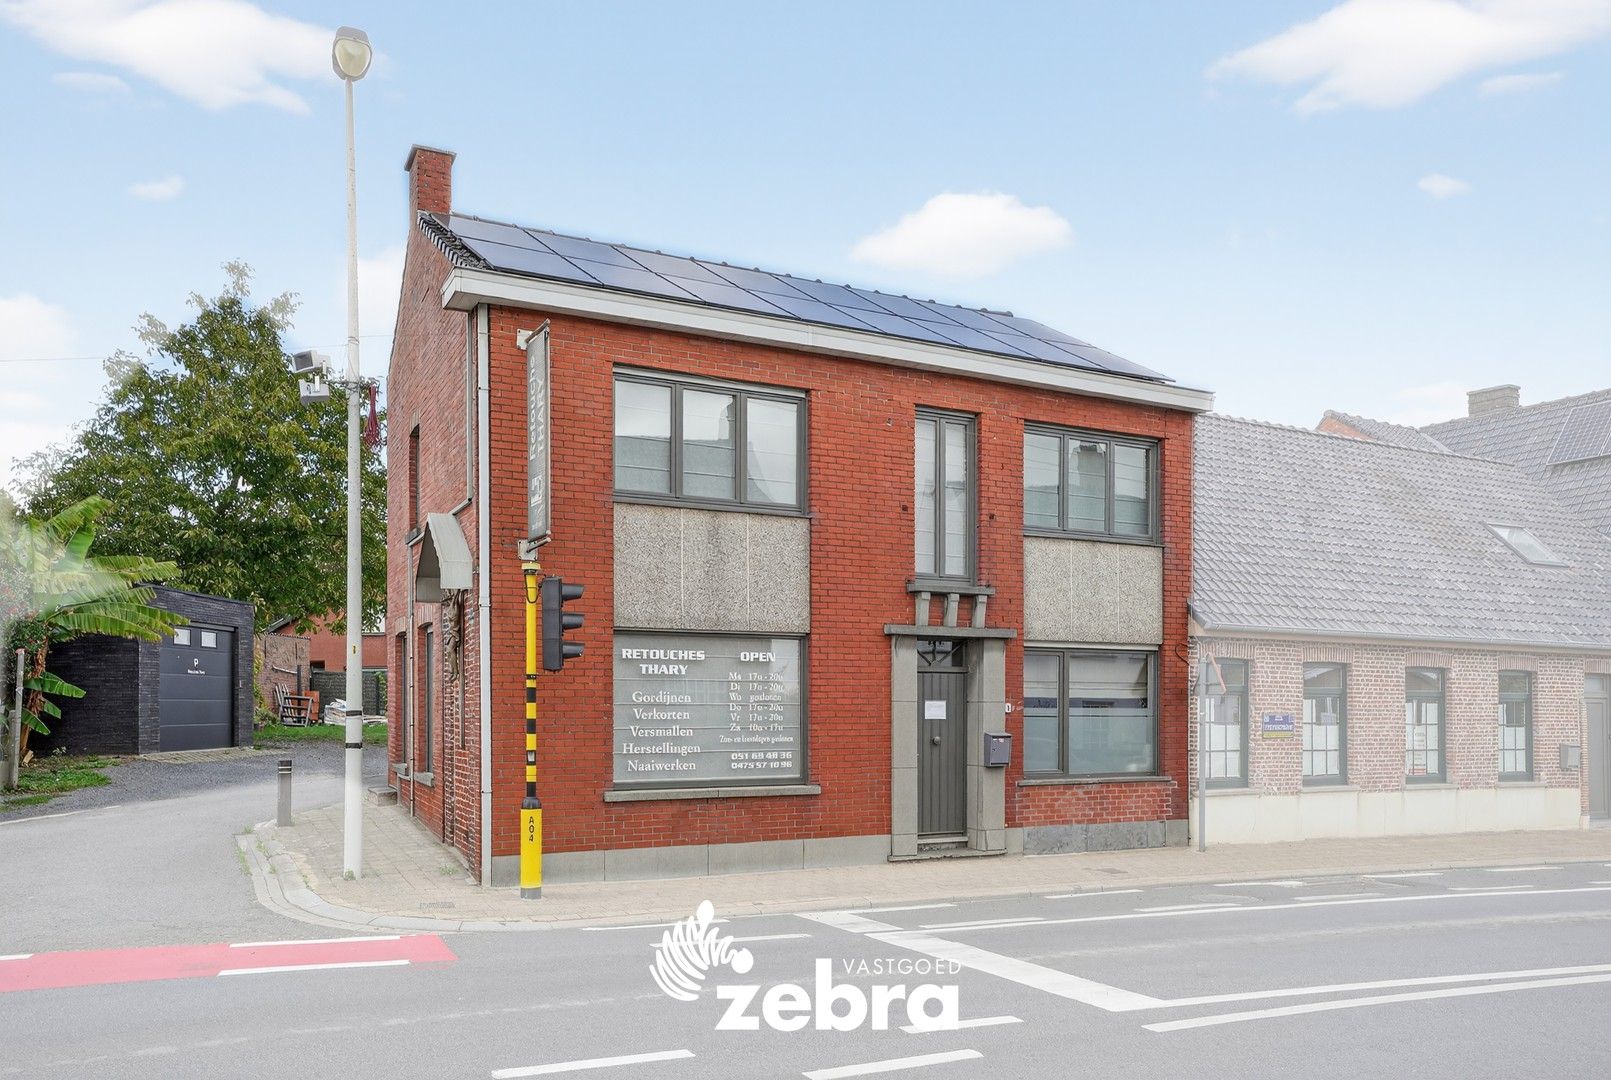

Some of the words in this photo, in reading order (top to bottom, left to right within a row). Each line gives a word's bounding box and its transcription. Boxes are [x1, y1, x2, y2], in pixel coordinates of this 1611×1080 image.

[621, 648, 706, 661] RETOUCHES
[740, 651, 776, 662] OPEN
[639, 664, 688, 675] THARY
[730, 682, 741, 691] Di
[632, 690, 692, 705] Gordijnen
[729, 703, 742, 711] Do
[633, 708, 690, 720] Verkorten
[730, 713, 741, 721] Vr
[630, 725, 693, 737] Versmallen
[622, 742, 701, 756] Herstellingen
[731, 752, 749, 760] 051
[627, 759, 696, 772] Naaiwerken
